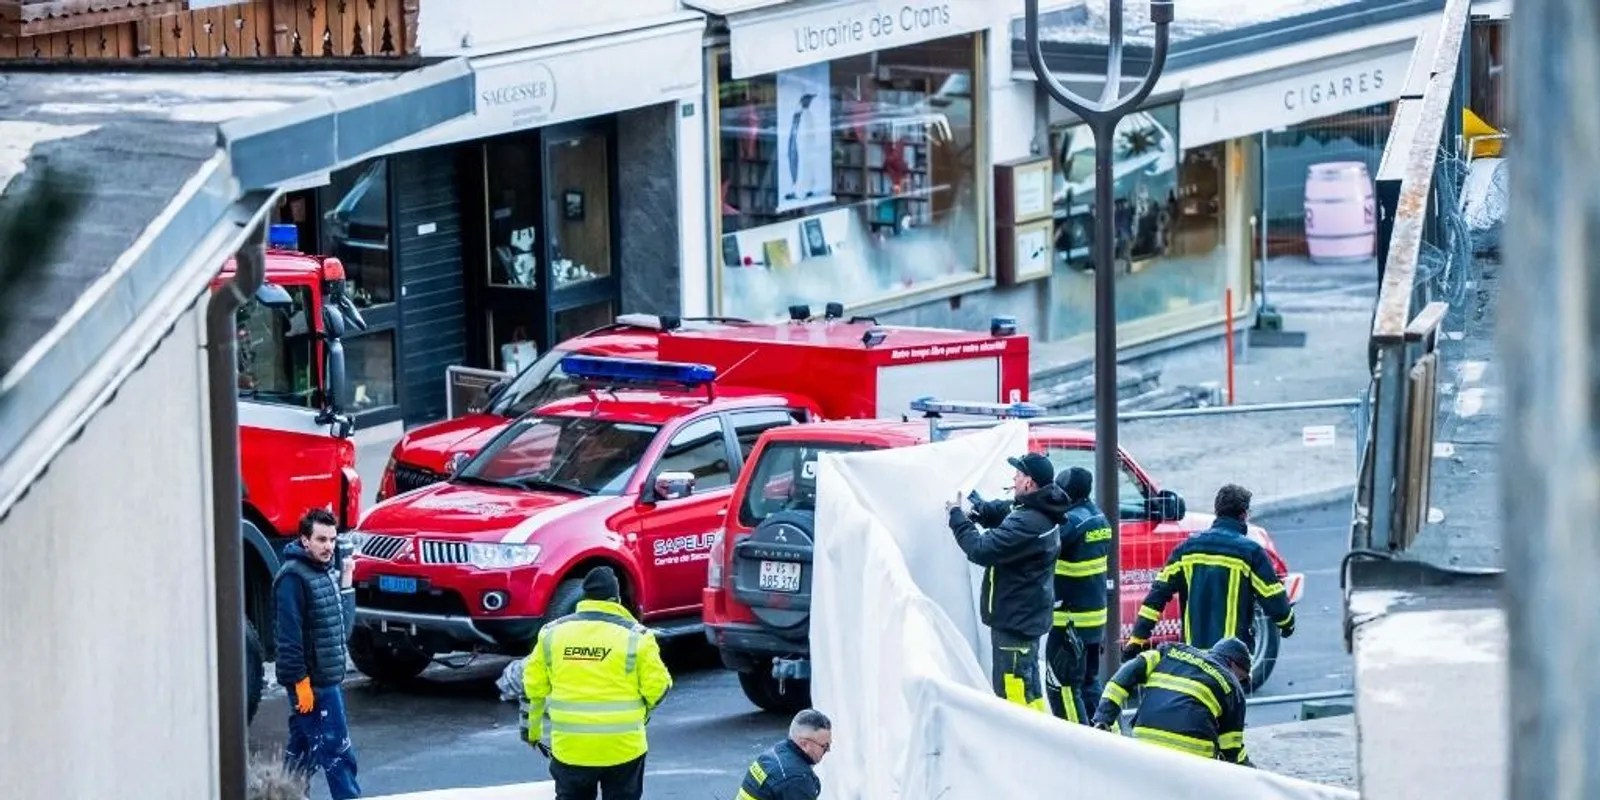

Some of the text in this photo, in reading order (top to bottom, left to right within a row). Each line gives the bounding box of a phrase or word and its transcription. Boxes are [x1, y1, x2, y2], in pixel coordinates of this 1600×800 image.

[795, 4, 950, 53] Librairie de Crans
[1284, 69, 1384, 110] CIGARES
[946, 345, 962, 357] pour
[654, 533, 716, 556] SAPEUR
[655, 556, 679, 566] Centre
[680, 554, 690, 562] de
[754, 550, 800, 558] PAJERO
[563, 646, 612, 661] EPINEY
